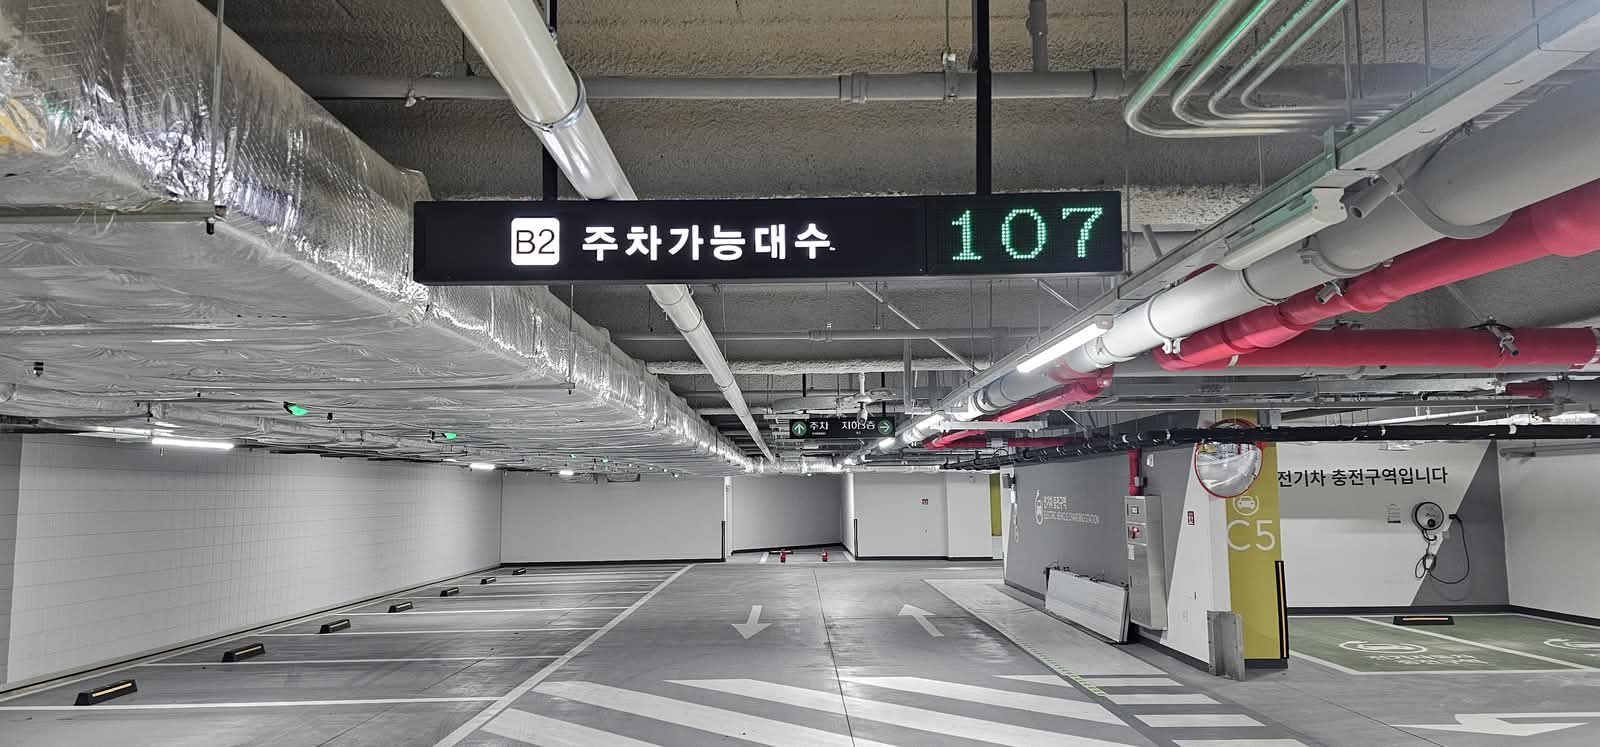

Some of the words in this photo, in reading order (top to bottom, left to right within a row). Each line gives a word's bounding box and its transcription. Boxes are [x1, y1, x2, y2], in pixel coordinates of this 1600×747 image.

[516, 229, 556, 255] B2
[581, 222, 831, 262] 주차가능대수
[951, 207, 1103, 261] 107
[1277, 470, 1326, 488] 전기차
[1331, 466, 1449, 487] 충전구역입니다
[1227, 519, 1276, 551] C5
